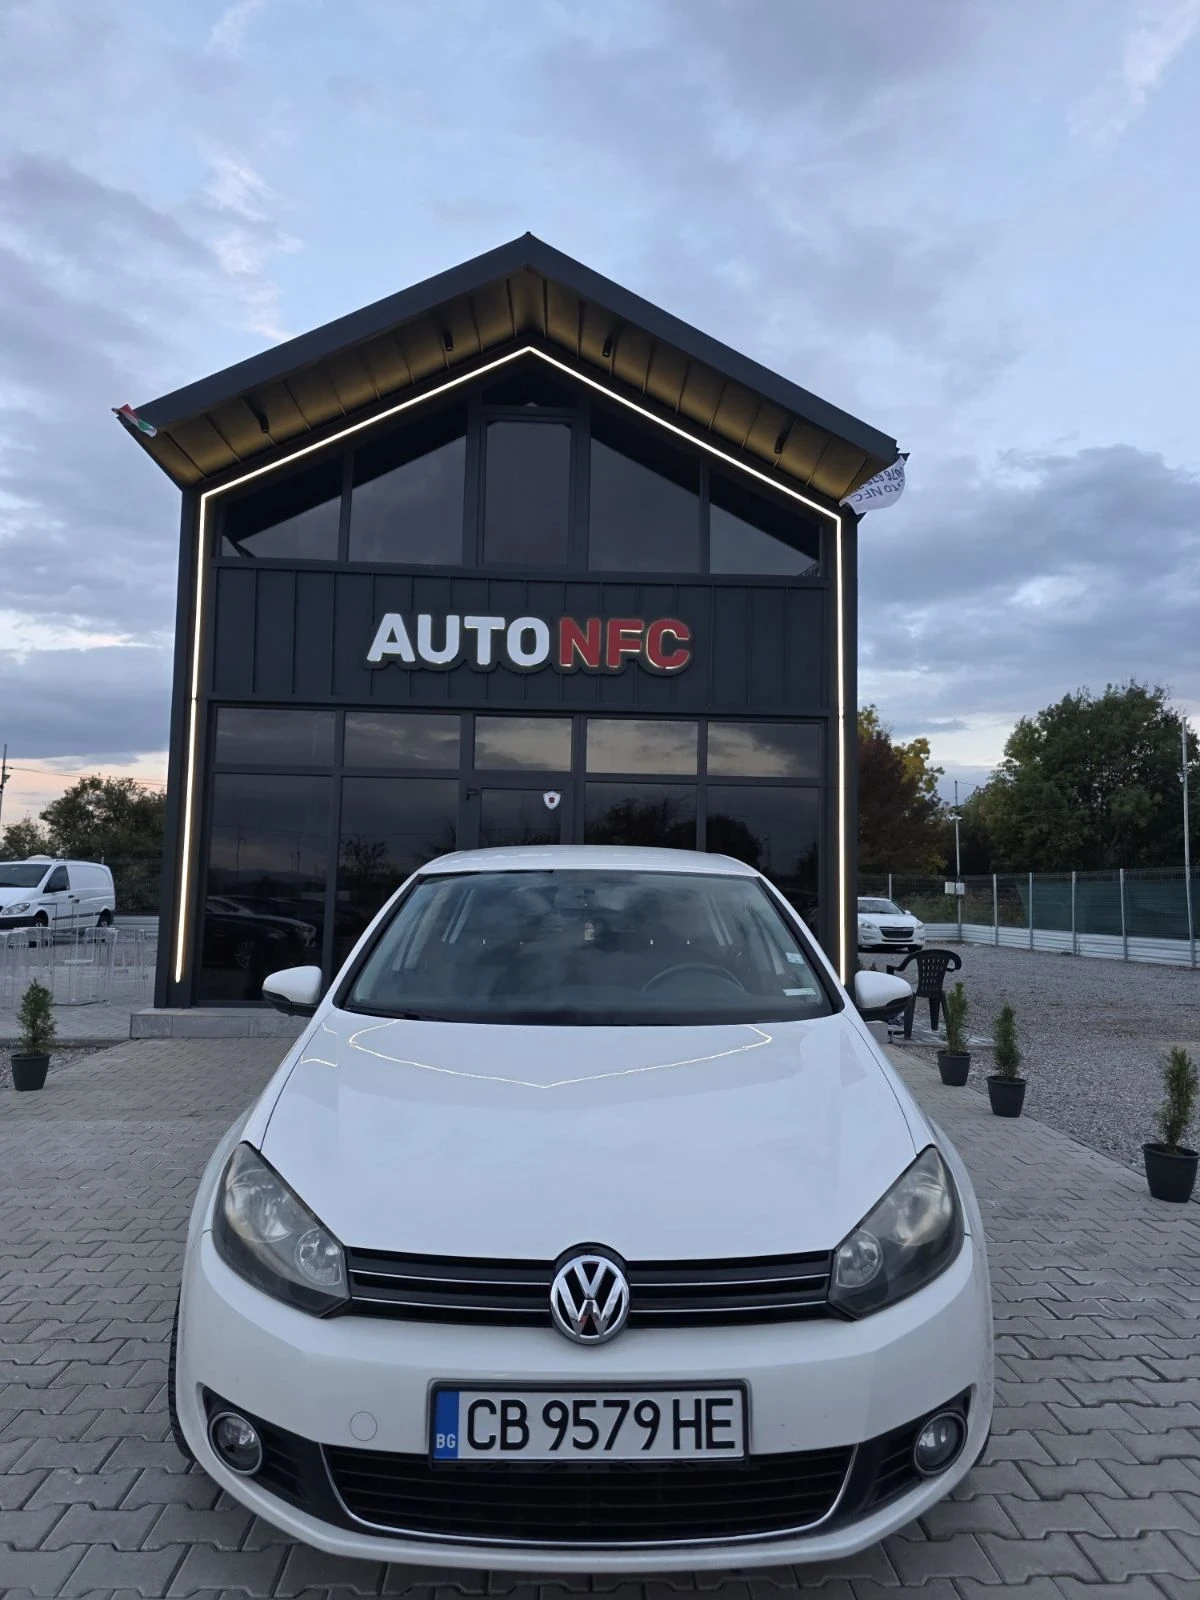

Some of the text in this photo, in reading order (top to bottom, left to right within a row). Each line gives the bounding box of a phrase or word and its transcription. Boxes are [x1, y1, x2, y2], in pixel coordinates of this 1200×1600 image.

[851, 486, 883, 502] NFC
[467, 1398, 736, 1451] CB 9579 HE
[436, 1433, 456, 1448] BG
